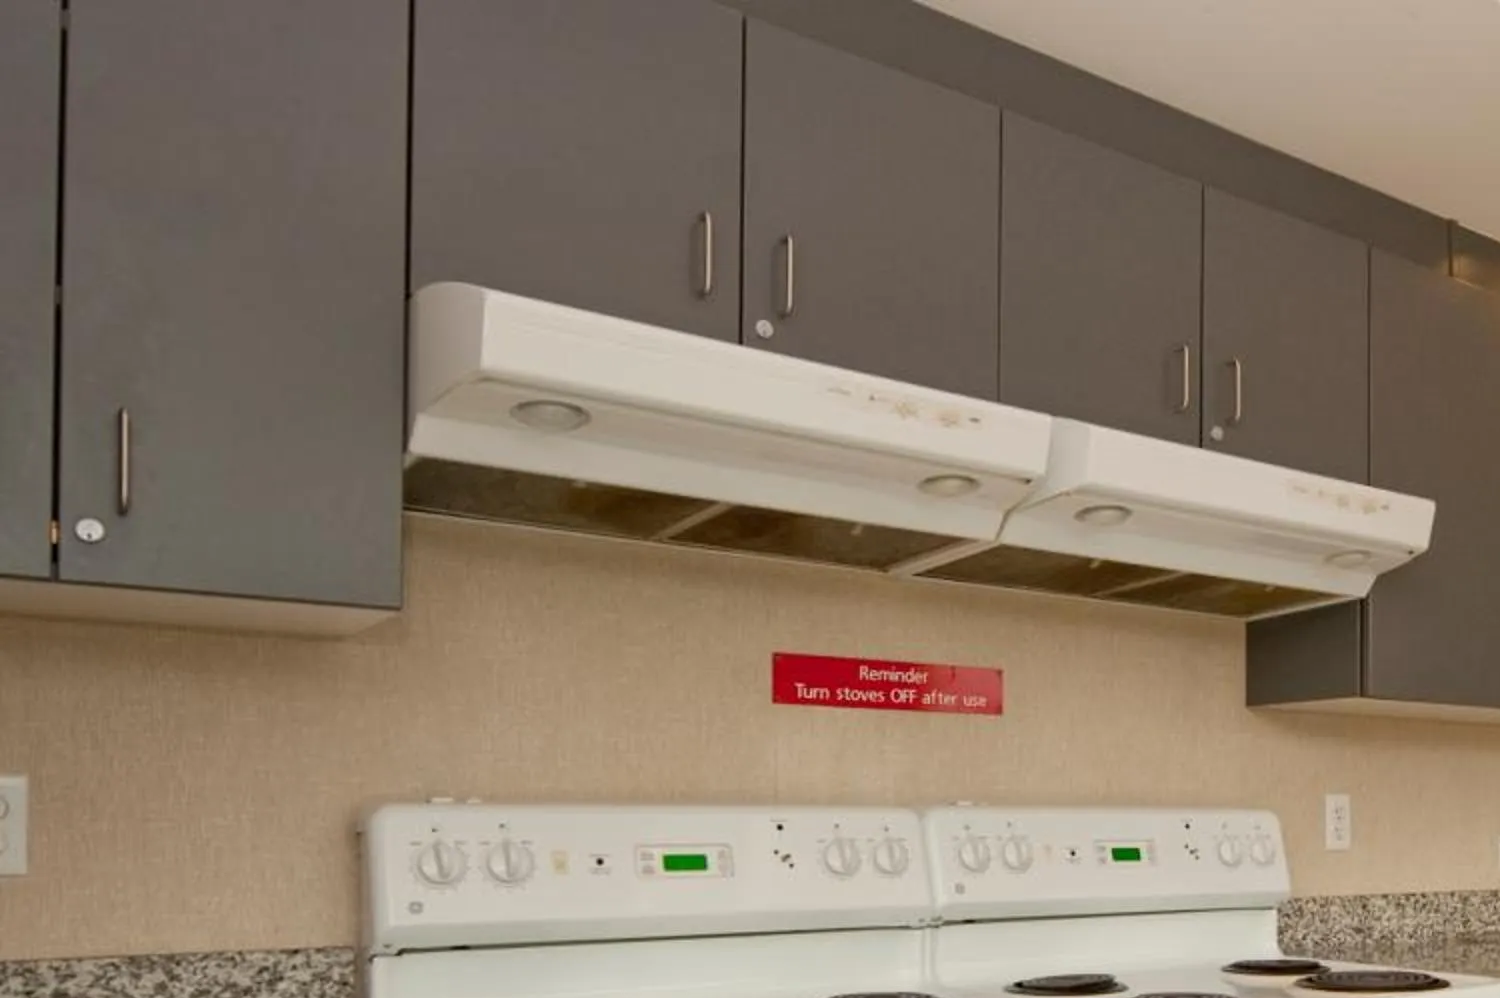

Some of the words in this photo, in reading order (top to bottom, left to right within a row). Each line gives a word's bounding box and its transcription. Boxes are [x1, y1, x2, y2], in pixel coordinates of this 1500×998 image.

[859, 665, 929, 684] Reminder
[795, 682, 830, 700] Turn
[836, 686, 885, 704] stoves
[890, 690, 917, 705] OFF
[922, 690, 957, 706] after
[963, 694, 987, 707] use
